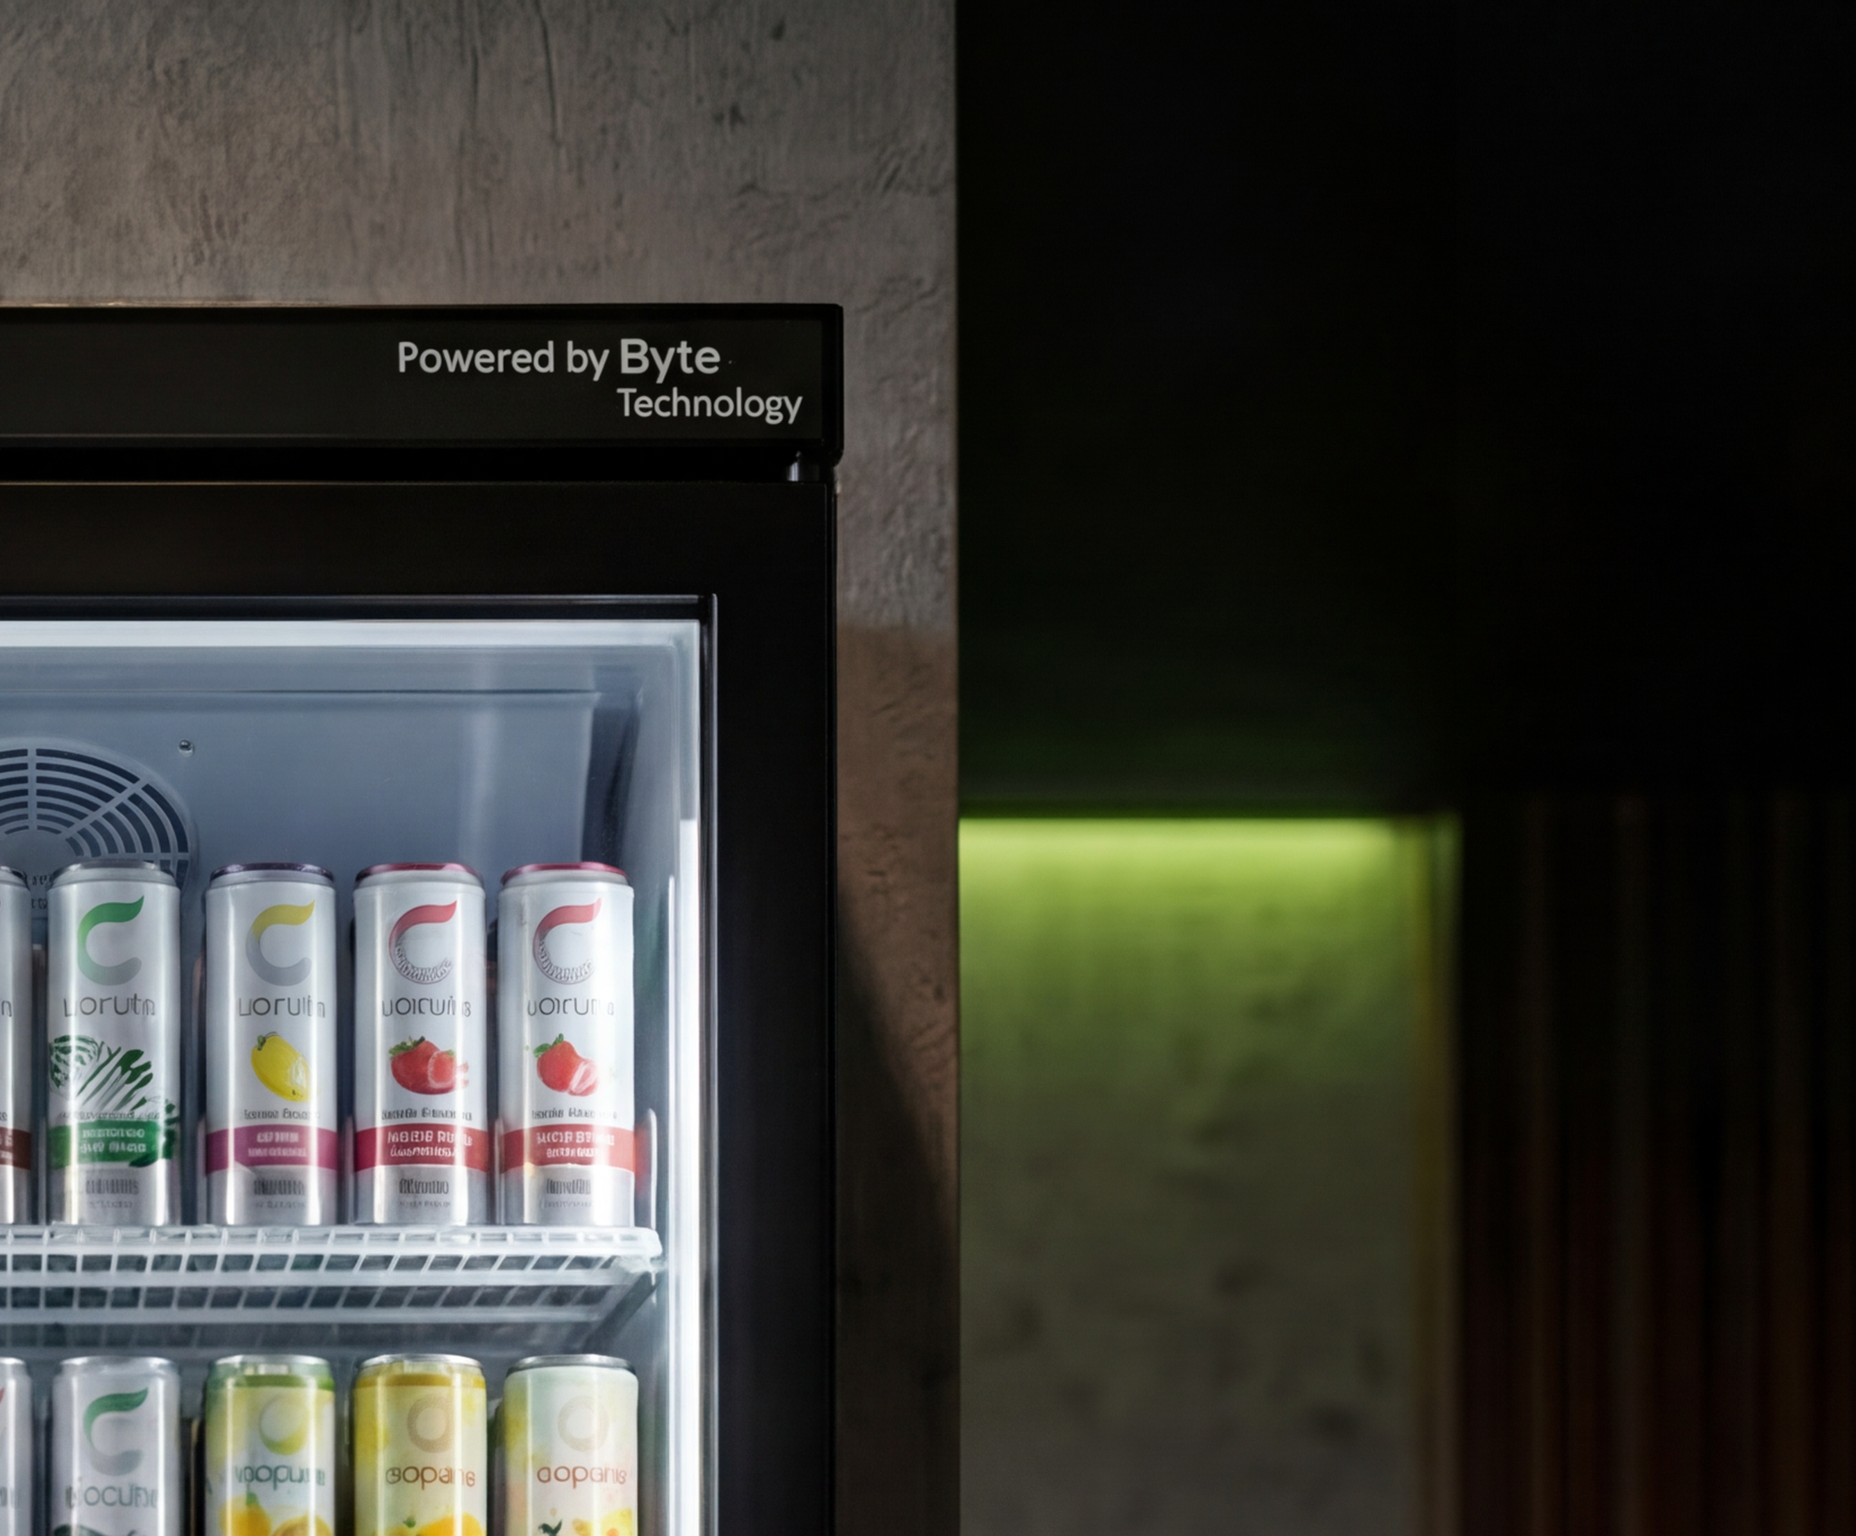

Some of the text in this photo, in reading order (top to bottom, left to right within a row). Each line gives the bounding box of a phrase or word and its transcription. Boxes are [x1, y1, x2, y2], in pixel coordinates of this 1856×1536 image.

[397, 338, 721, 384] Powered by Byte
[616, 386, 804, 425] Technology
